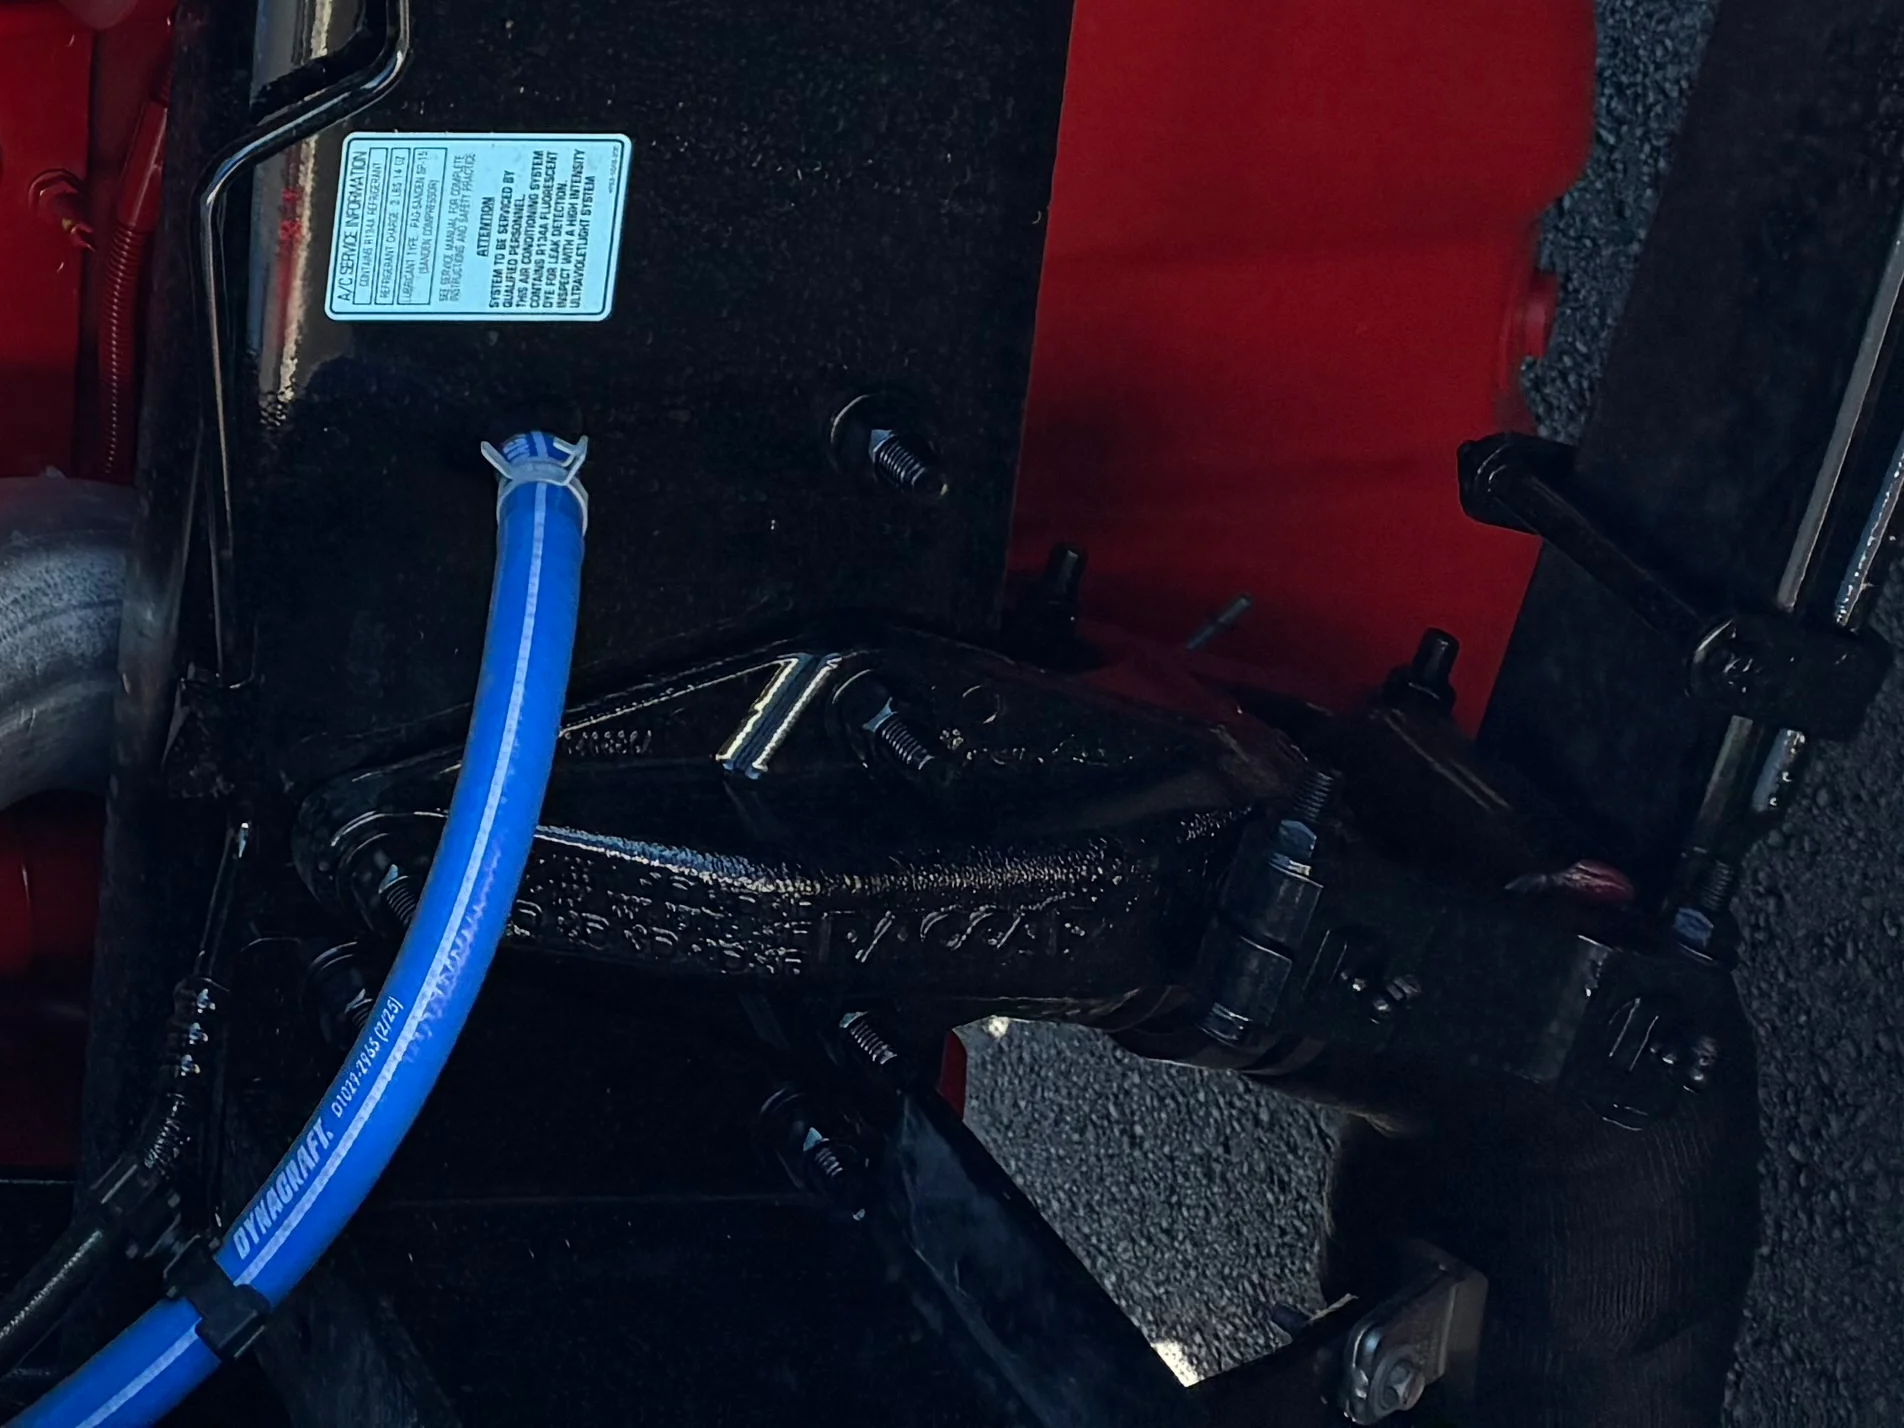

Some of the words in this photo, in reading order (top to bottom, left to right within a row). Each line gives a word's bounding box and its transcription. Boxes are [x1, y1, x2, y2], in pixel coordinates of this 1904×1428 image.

[345, 149, 367, 228] INFORMATION
[367, 161, 382, 215] REFRIGERANT
[450, 154, 464, 196] COMPLETE
[503, 169, 515, 184] BY
[529, 149, 544, 191] SYSTEM
[539, 150, 557, 220] FLUORESCENT
[568, 148, 585, 200] INTENSITY
[448, 198, 459, 214] FOR
[458, 193, 471, 223] SAFETY
[497, 186, 513, 234] SERVICED
[551, 179, 568, 237] DETECTION.
[566, 202, 578, 226] HIGH
[580, 174, 595, 216] SYSTEM
[444, 216, 457, 251] MANUAL
[456, 224, 467, 243] AND
[475, 195, 493, 257] ATTENTION
[495, 237, 507, 250] BE
[508, 193, 525, 255] PERSONNEL.
[520, 192, 539, 265] CONDITIONING
[535, 222, 549, 255] R134A
[565, 228, 575, 236] A
[340, 230, 358, 275] SERVICE
[379, 245, 394, 298] REFRIGERANT
[440, 253, 453, 285] SERVICE
[493, 252, 505, 266] TO
[548, 239, 561, 264] LEAK
[561, 238, 574, 265] WITH
[336, 276, 353, 301] A/C
[488, 268, 503, 308] SYSTEM
[502, 258, 518, 308] QUALIFIED
[518, 266, 530, 284] AIR
[529, 257, 545, 308] CONTAINS
[545, 266, 557, 286] FOR
[556, 267, 571, 308] INSPECT
[516, 286, 528, 308] THIS
[543, 289, 555, 308] DYE
[327, 1036, 388, 1118] D1029-2965
[367, 993, 406, 1042] (2/25)
